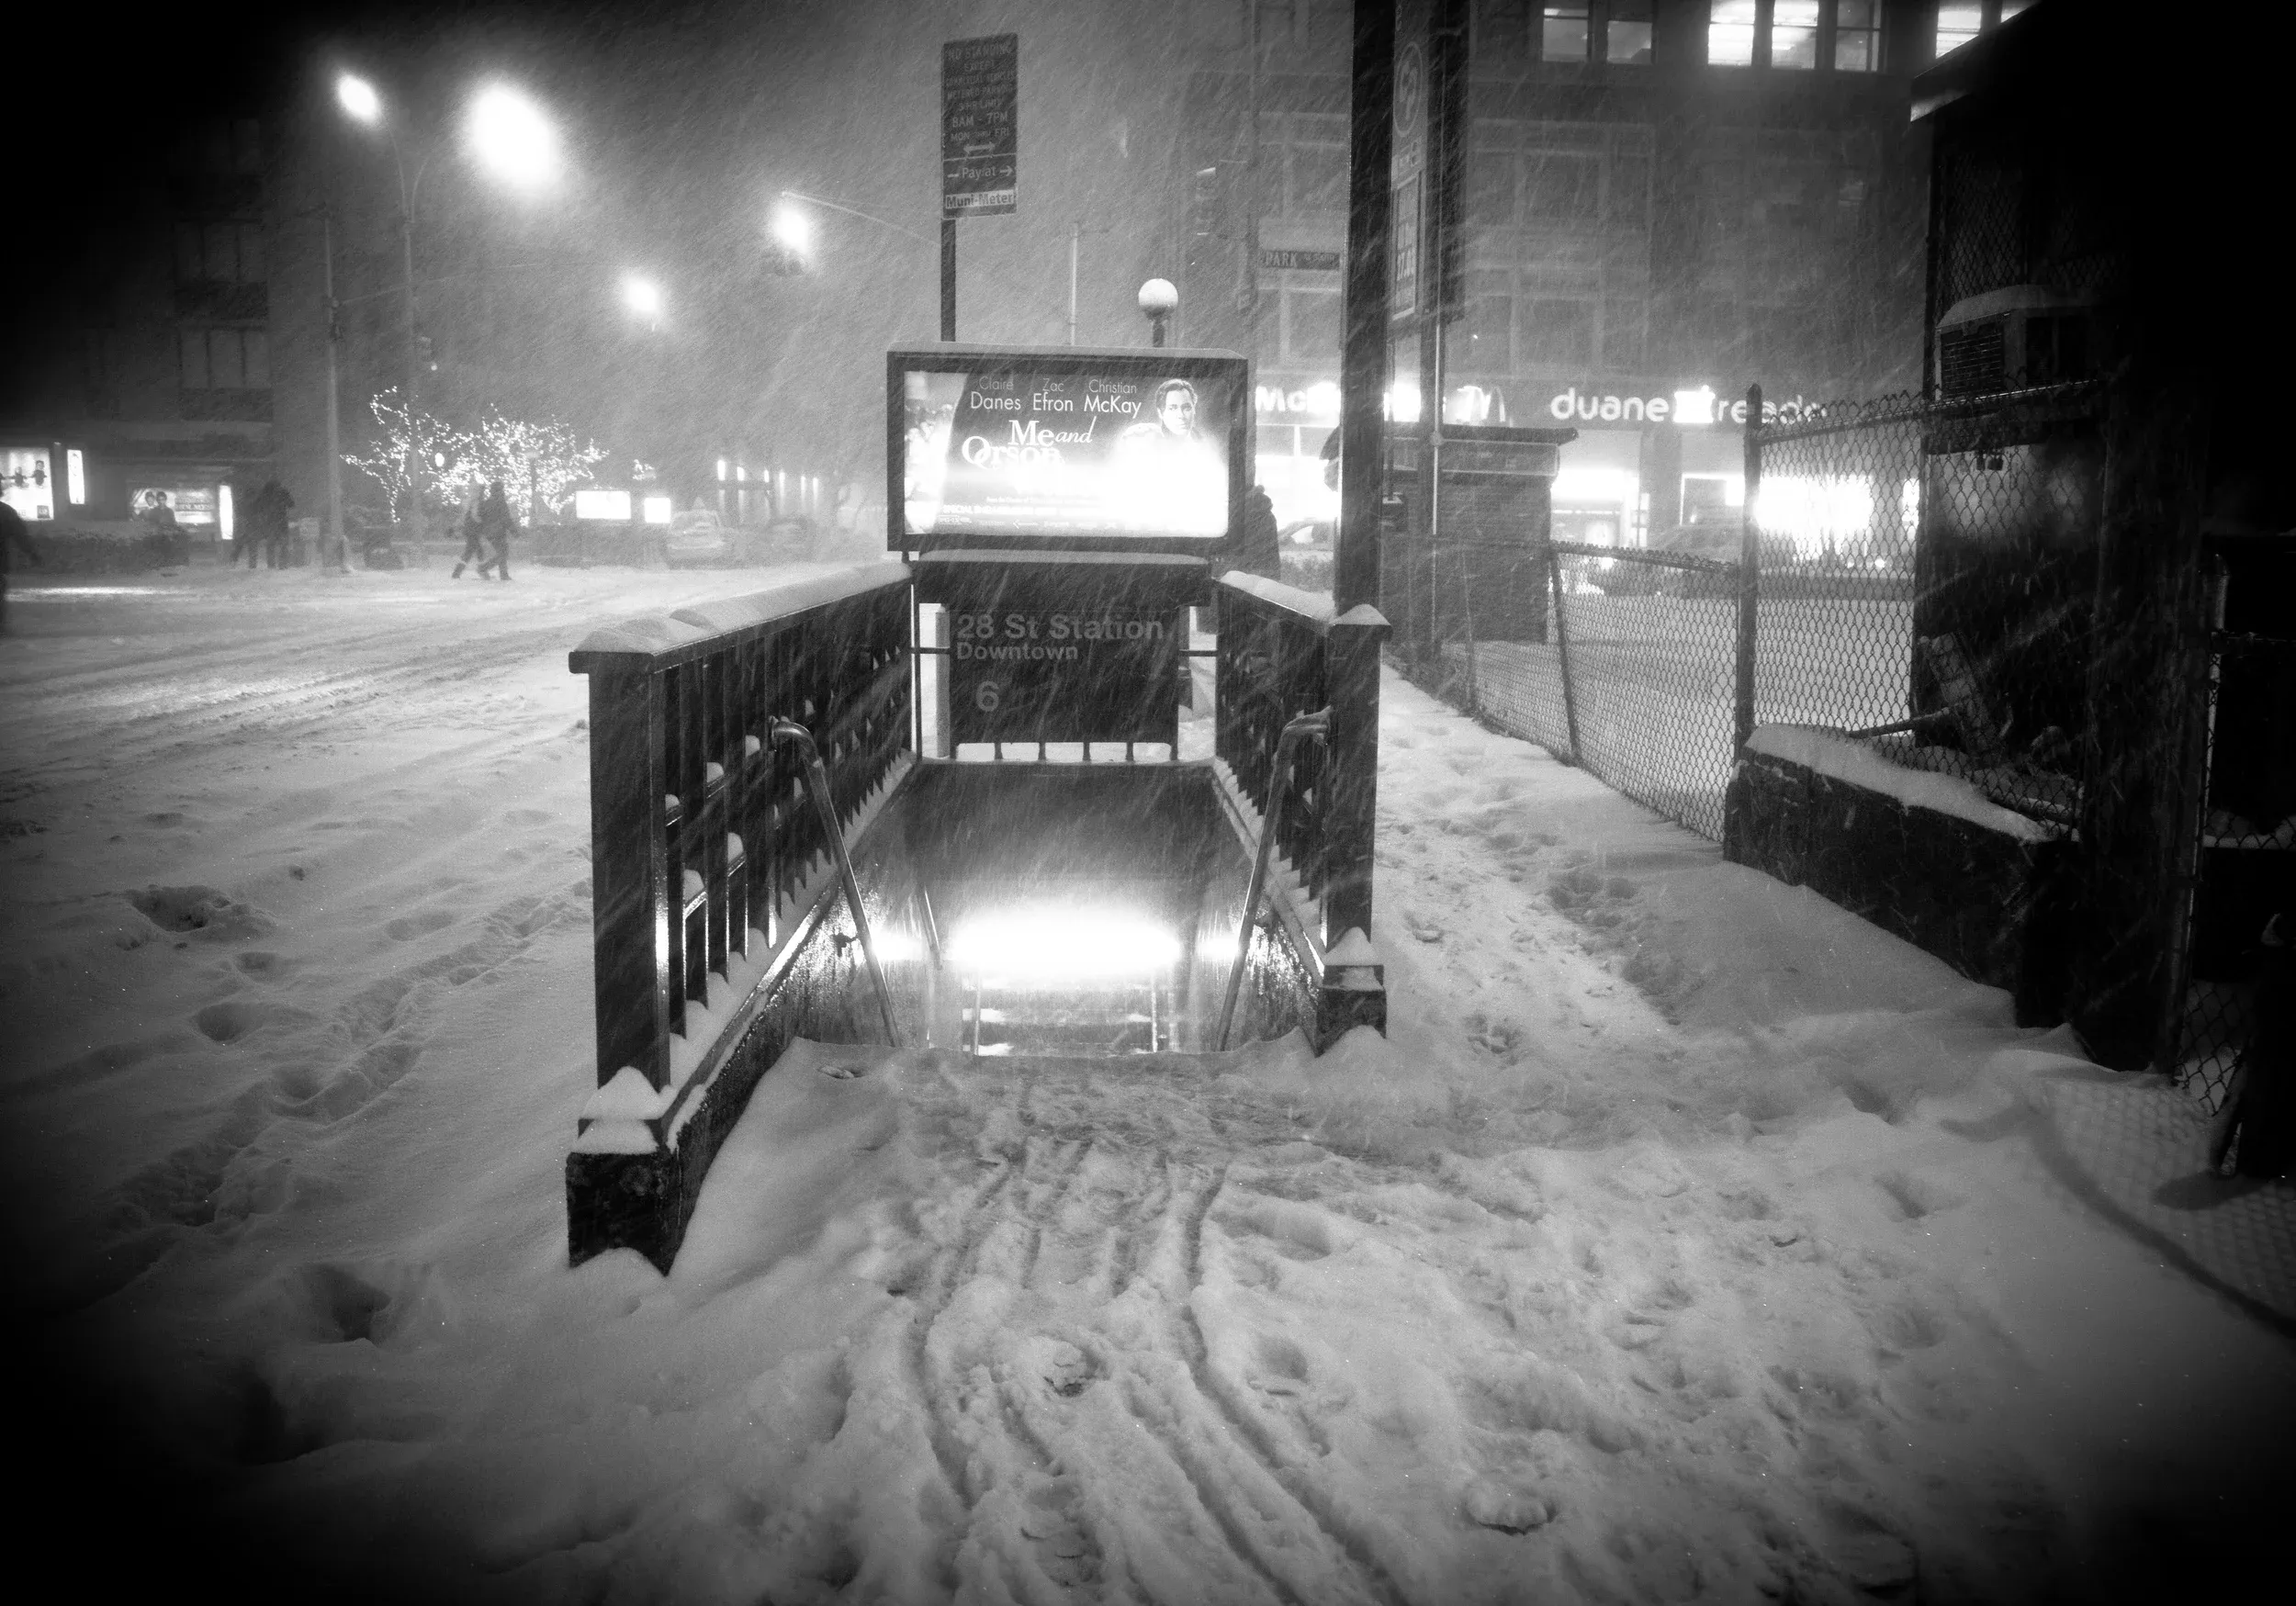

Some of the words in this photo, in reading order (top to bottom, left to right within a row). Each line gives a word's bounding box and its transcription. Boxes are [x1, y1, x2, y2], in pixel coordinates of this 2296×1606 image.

[951, 115, 974, 128] 8AM
[986, 111, 1007, 125] 7PM
[951, 130, 970, 142] MON
[995, 127, 1010, 138] FRI
[962, 167, 981, 181] Pay
[985, 165, 996, 176] at
[945, 193, 1014, 209] Muni-Meter
[1266, 252, 1297, 267] PARK
[979, 376, 1014, 390] Claire
[1042, 377, 1064, 392] Zac
[1088, 379, 1137, 394] Christian
[970, 391, 1021, 410] Danes
[1033, 391, 1074, 411] Efron
[1084, 395, 1142, 419] McKay
[1550, 387, 1670, 422] duane
[1007, 420, 1055, 447] Me
[1055, 415, 1097, 444] and
[957, 613, 995, 639] 28
[1005, 613, 1039, 639] St
[1048, 612, 1164, 639] Station
[957, 642, 1078, 660] Downtown
[975, 679, 1000, 713] 6
